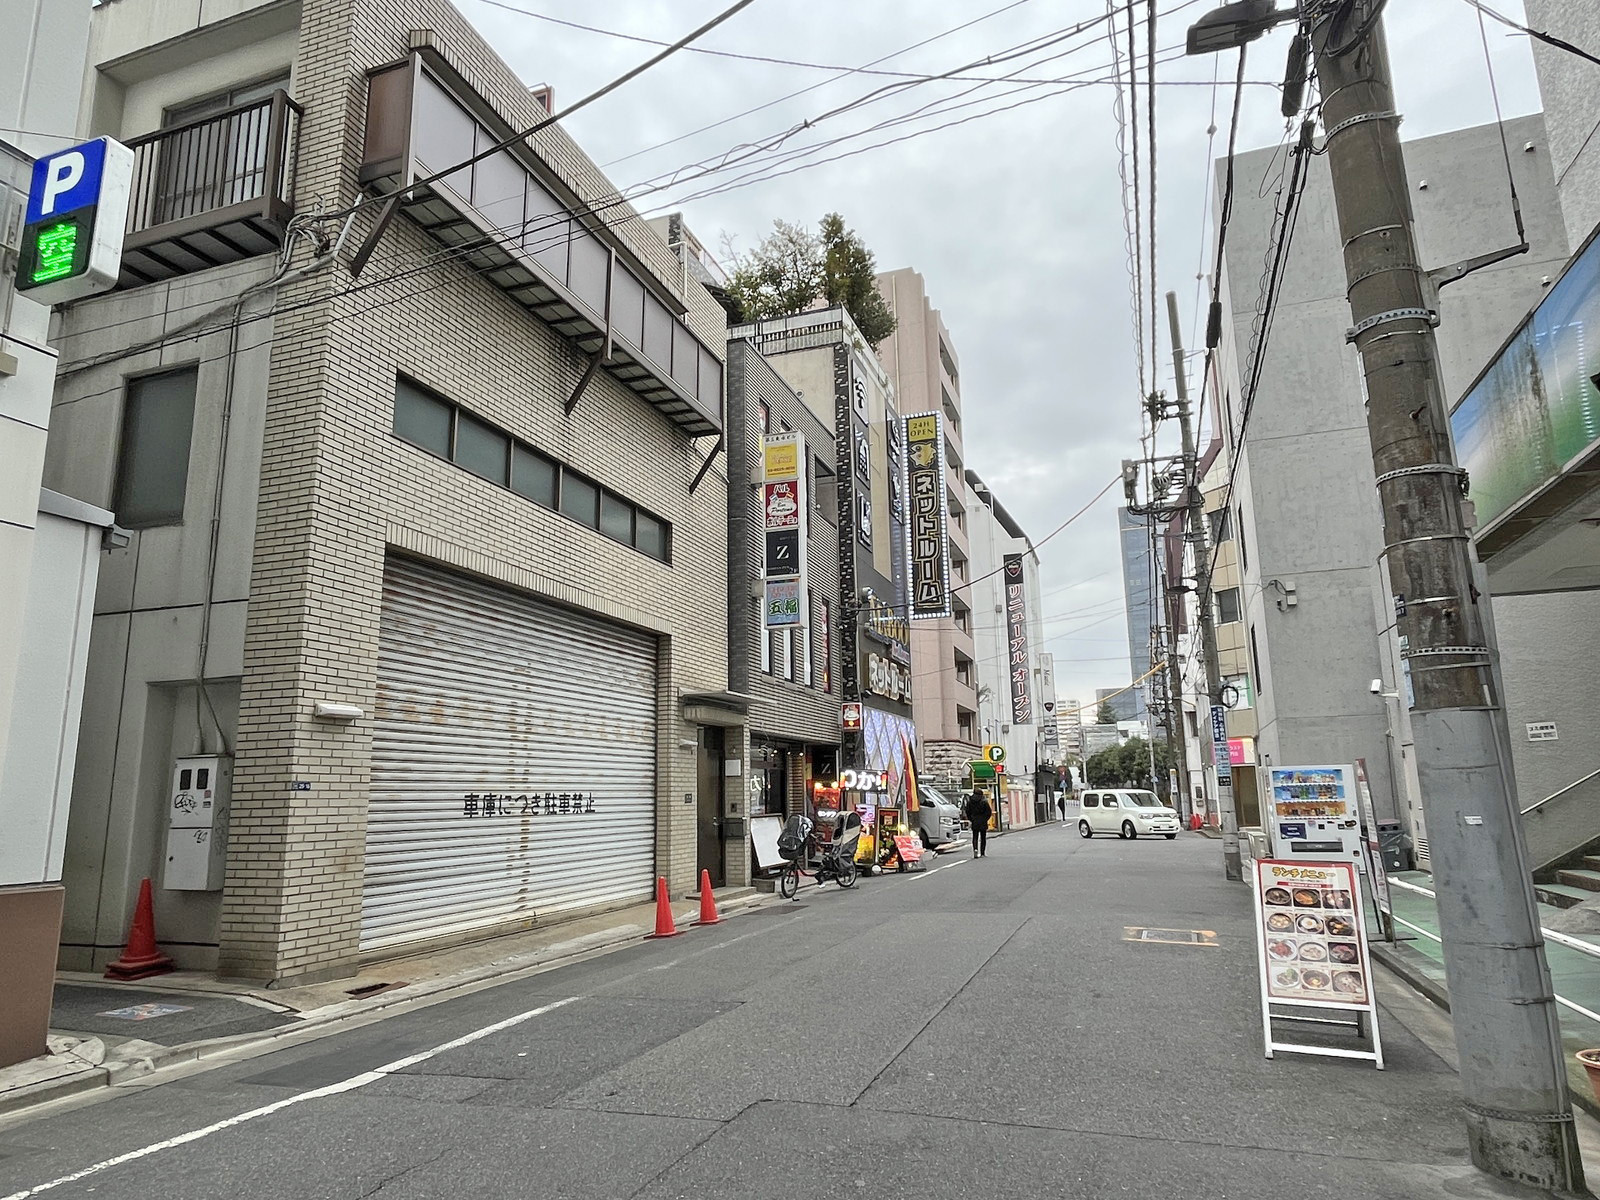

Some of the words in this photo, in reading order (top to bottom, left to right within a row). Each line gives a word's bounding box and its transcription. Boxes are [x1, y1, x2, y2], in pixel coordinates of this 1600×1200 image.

[41, 151, 85, 216] P
[33, 223, 77, 283] 空
[910, 427, 935, 438] OPEN
[912, 420, 931, 429] 24H
[913, 473, 941, 605] ネットルーム
[776, 545, 790, 560] Z
[869, 655, 911, 702] ネットルーム
[992, 747, 1003, 760] P
[463, 792, 596, 818] 車庫につき駐車禁止
